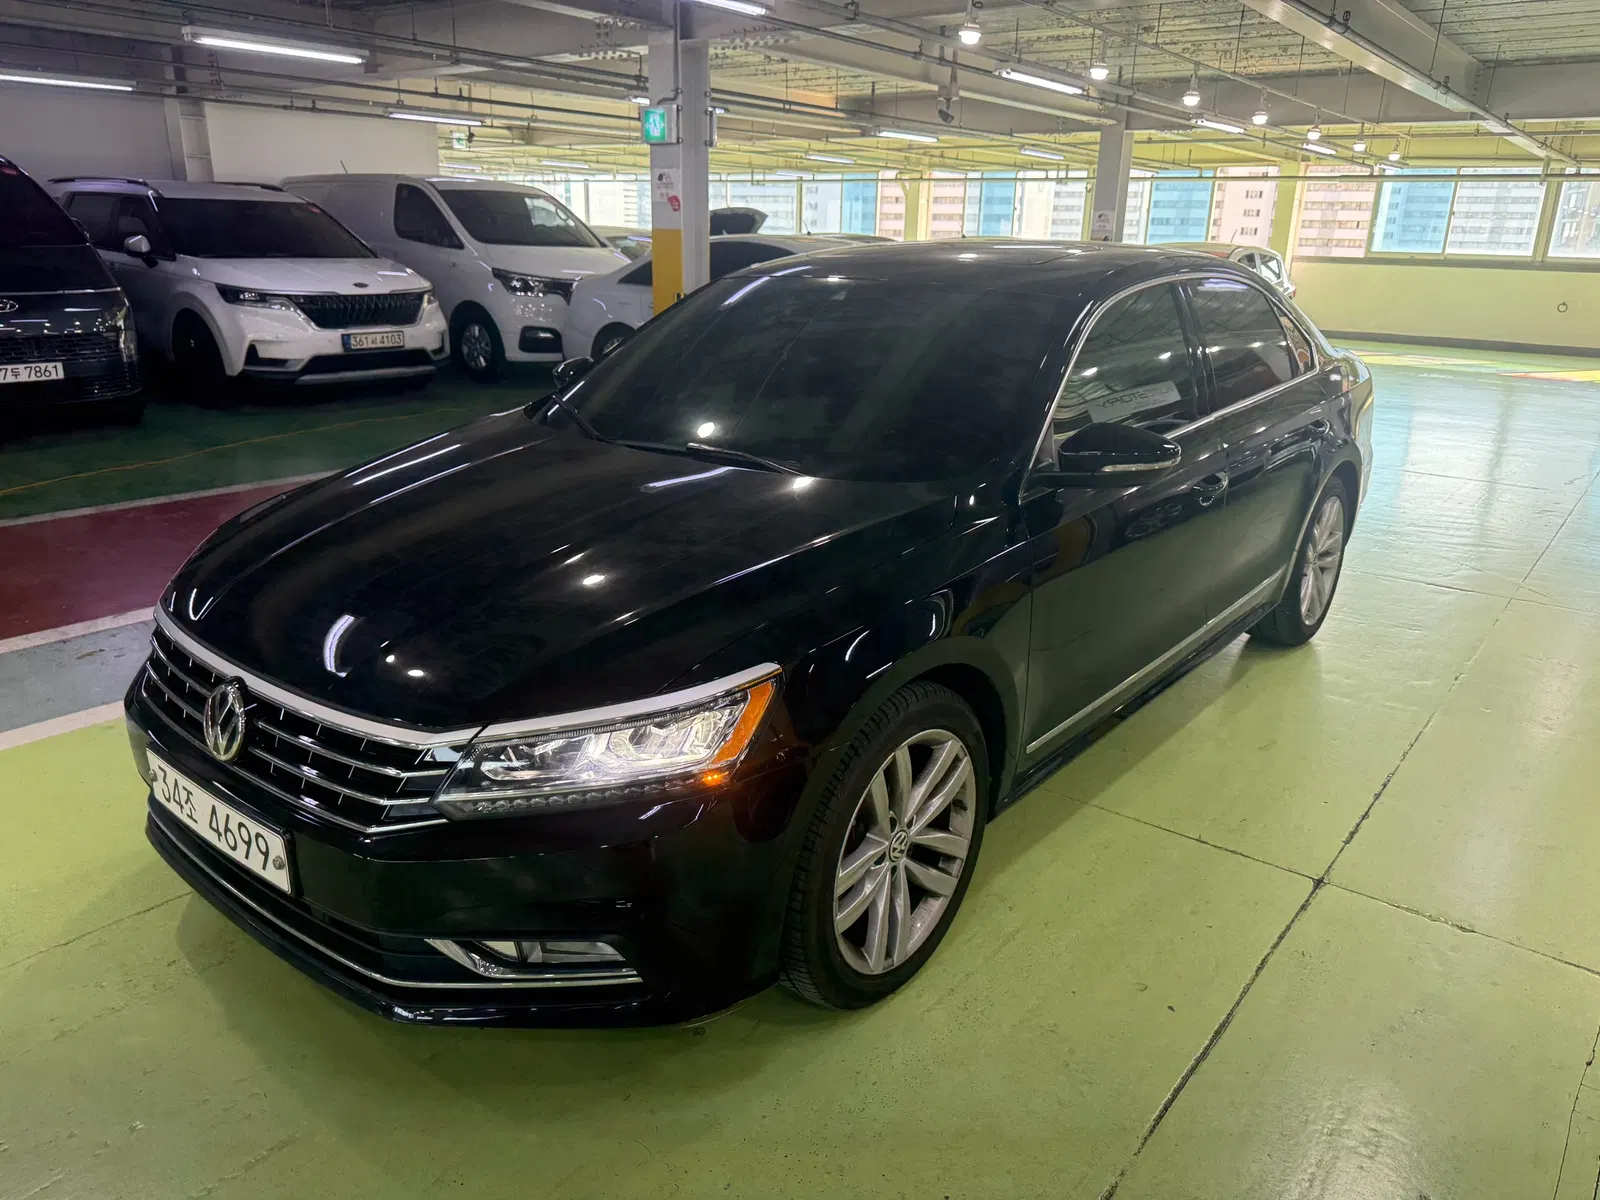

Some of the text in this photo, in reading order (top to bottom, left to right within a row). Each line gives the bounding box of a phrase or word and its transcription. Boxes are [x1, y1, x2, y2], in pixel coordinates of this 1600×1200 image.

[379, 333, 402, 345] 4103
[24, 364, 59, 379] 7861
[158, 764, 270, 871] 34조 4699
